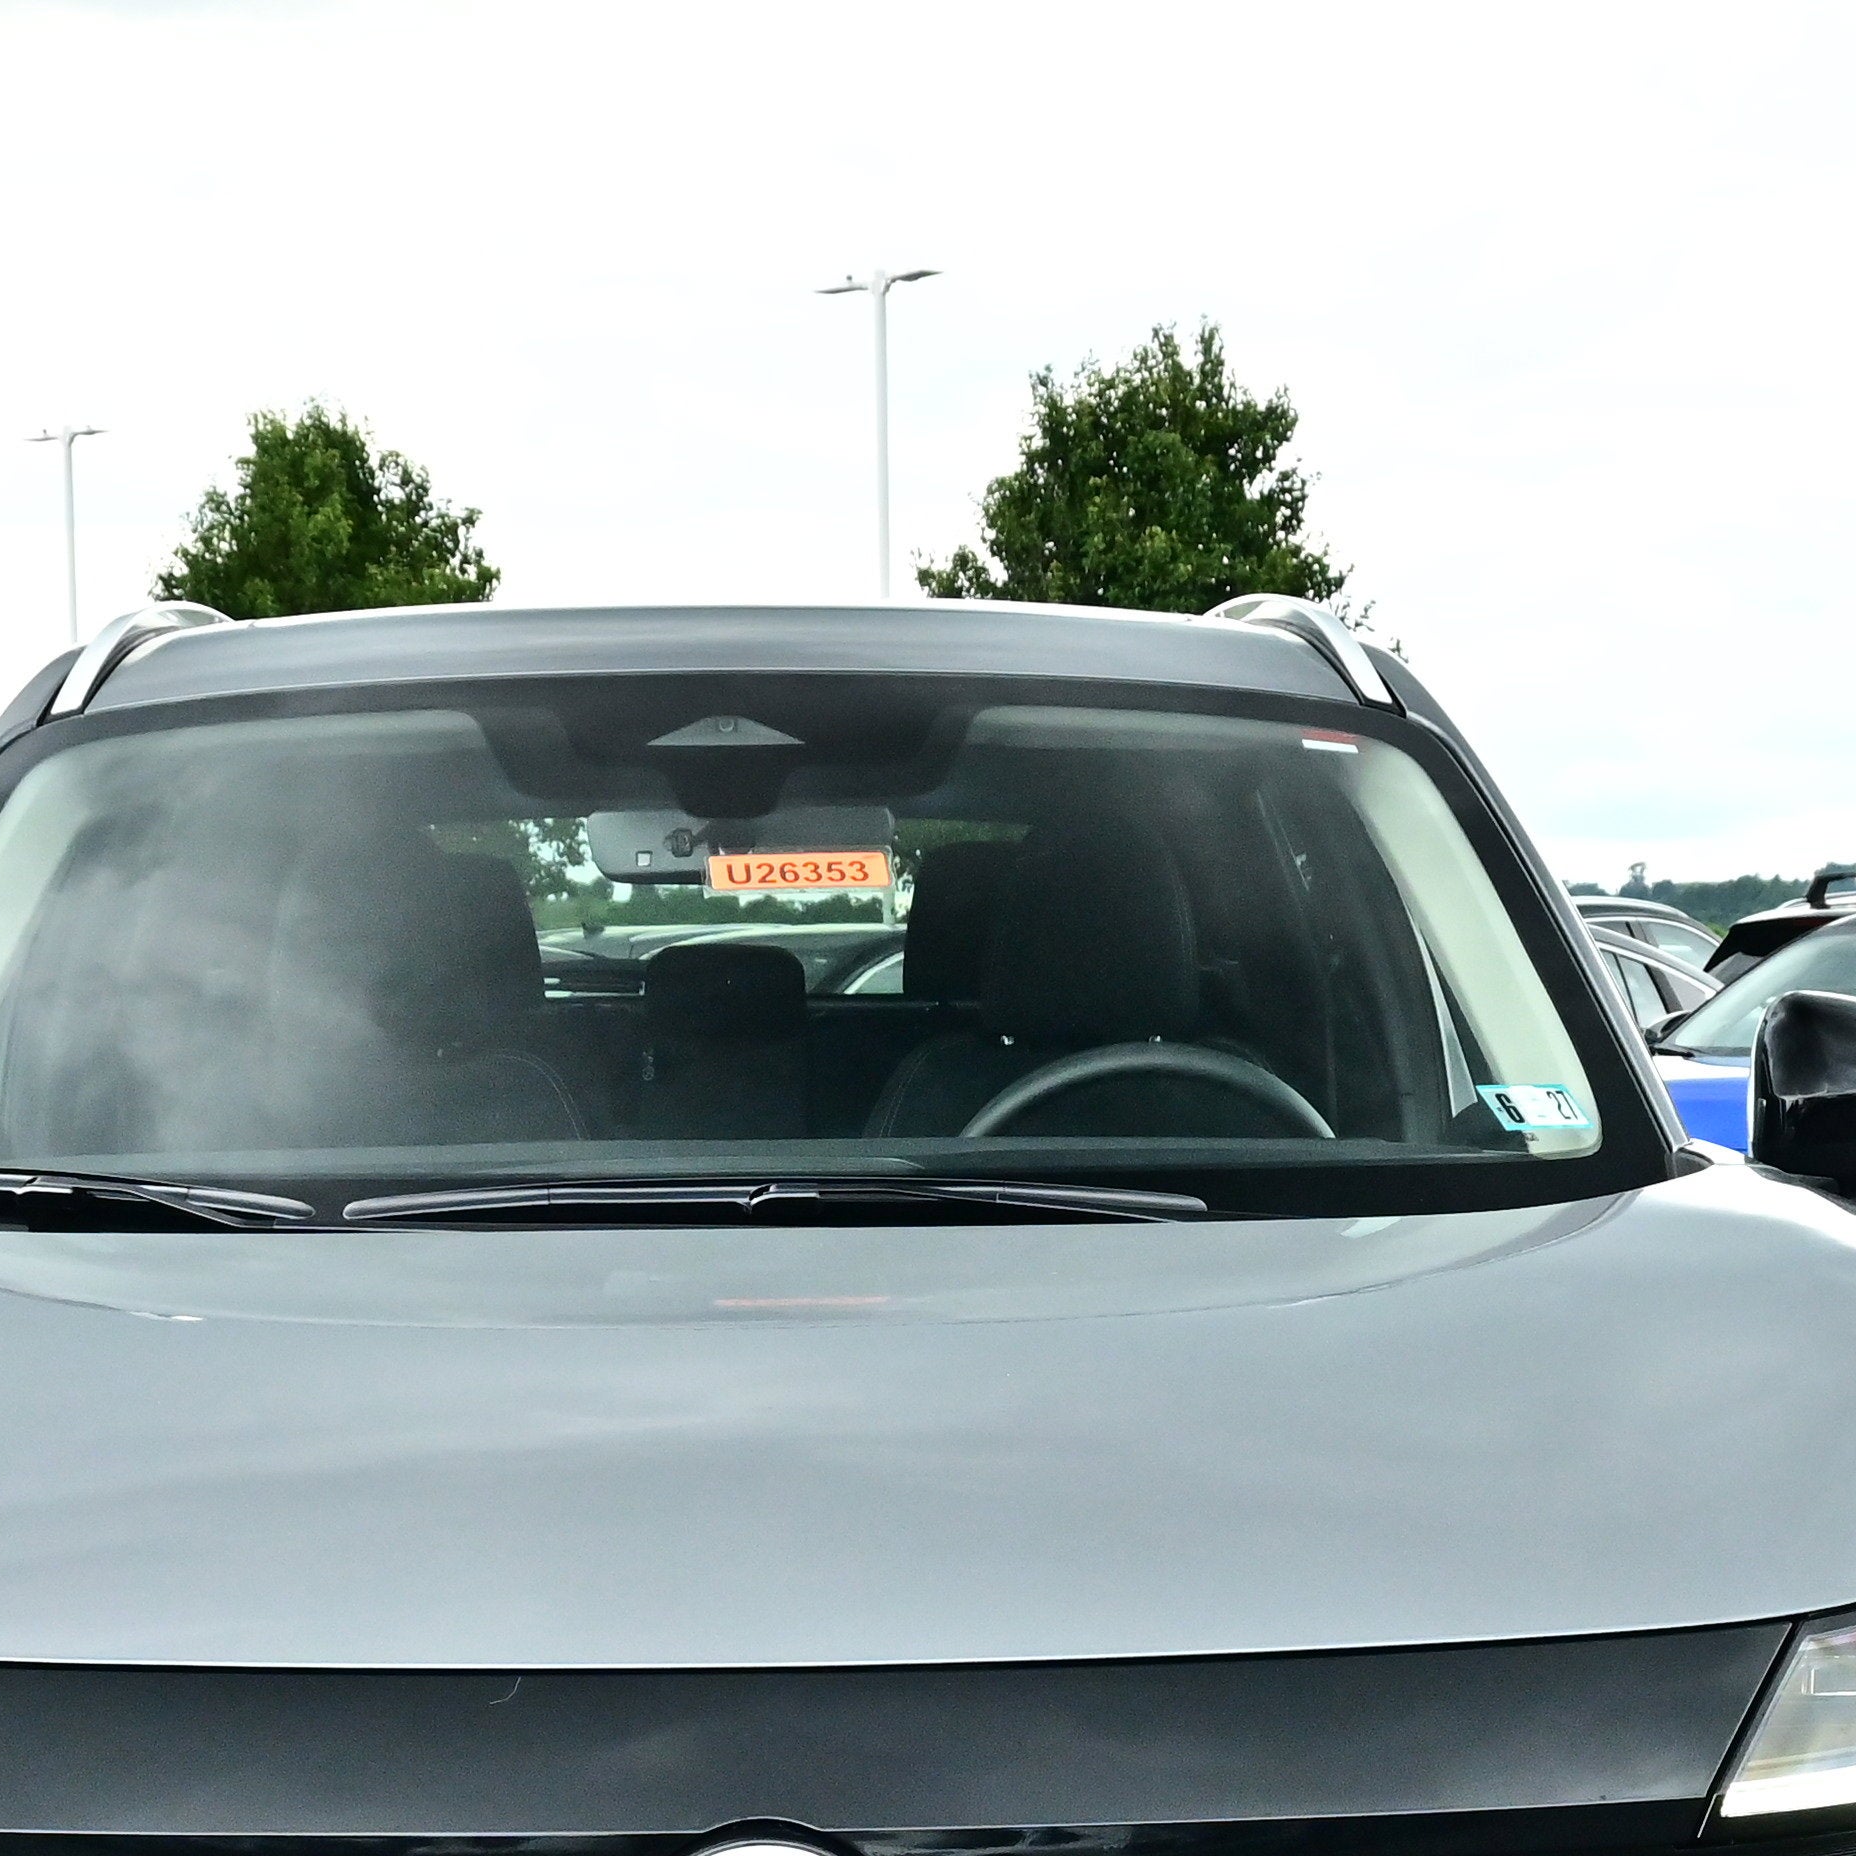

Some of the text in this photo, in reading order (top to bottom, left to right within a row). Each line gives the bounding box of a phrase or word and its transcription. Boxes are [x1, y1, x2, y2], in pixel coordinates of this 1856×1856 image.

[726, 860, 870, 885] U26353
[1494, 1090, 1579, 1123] 6 27
